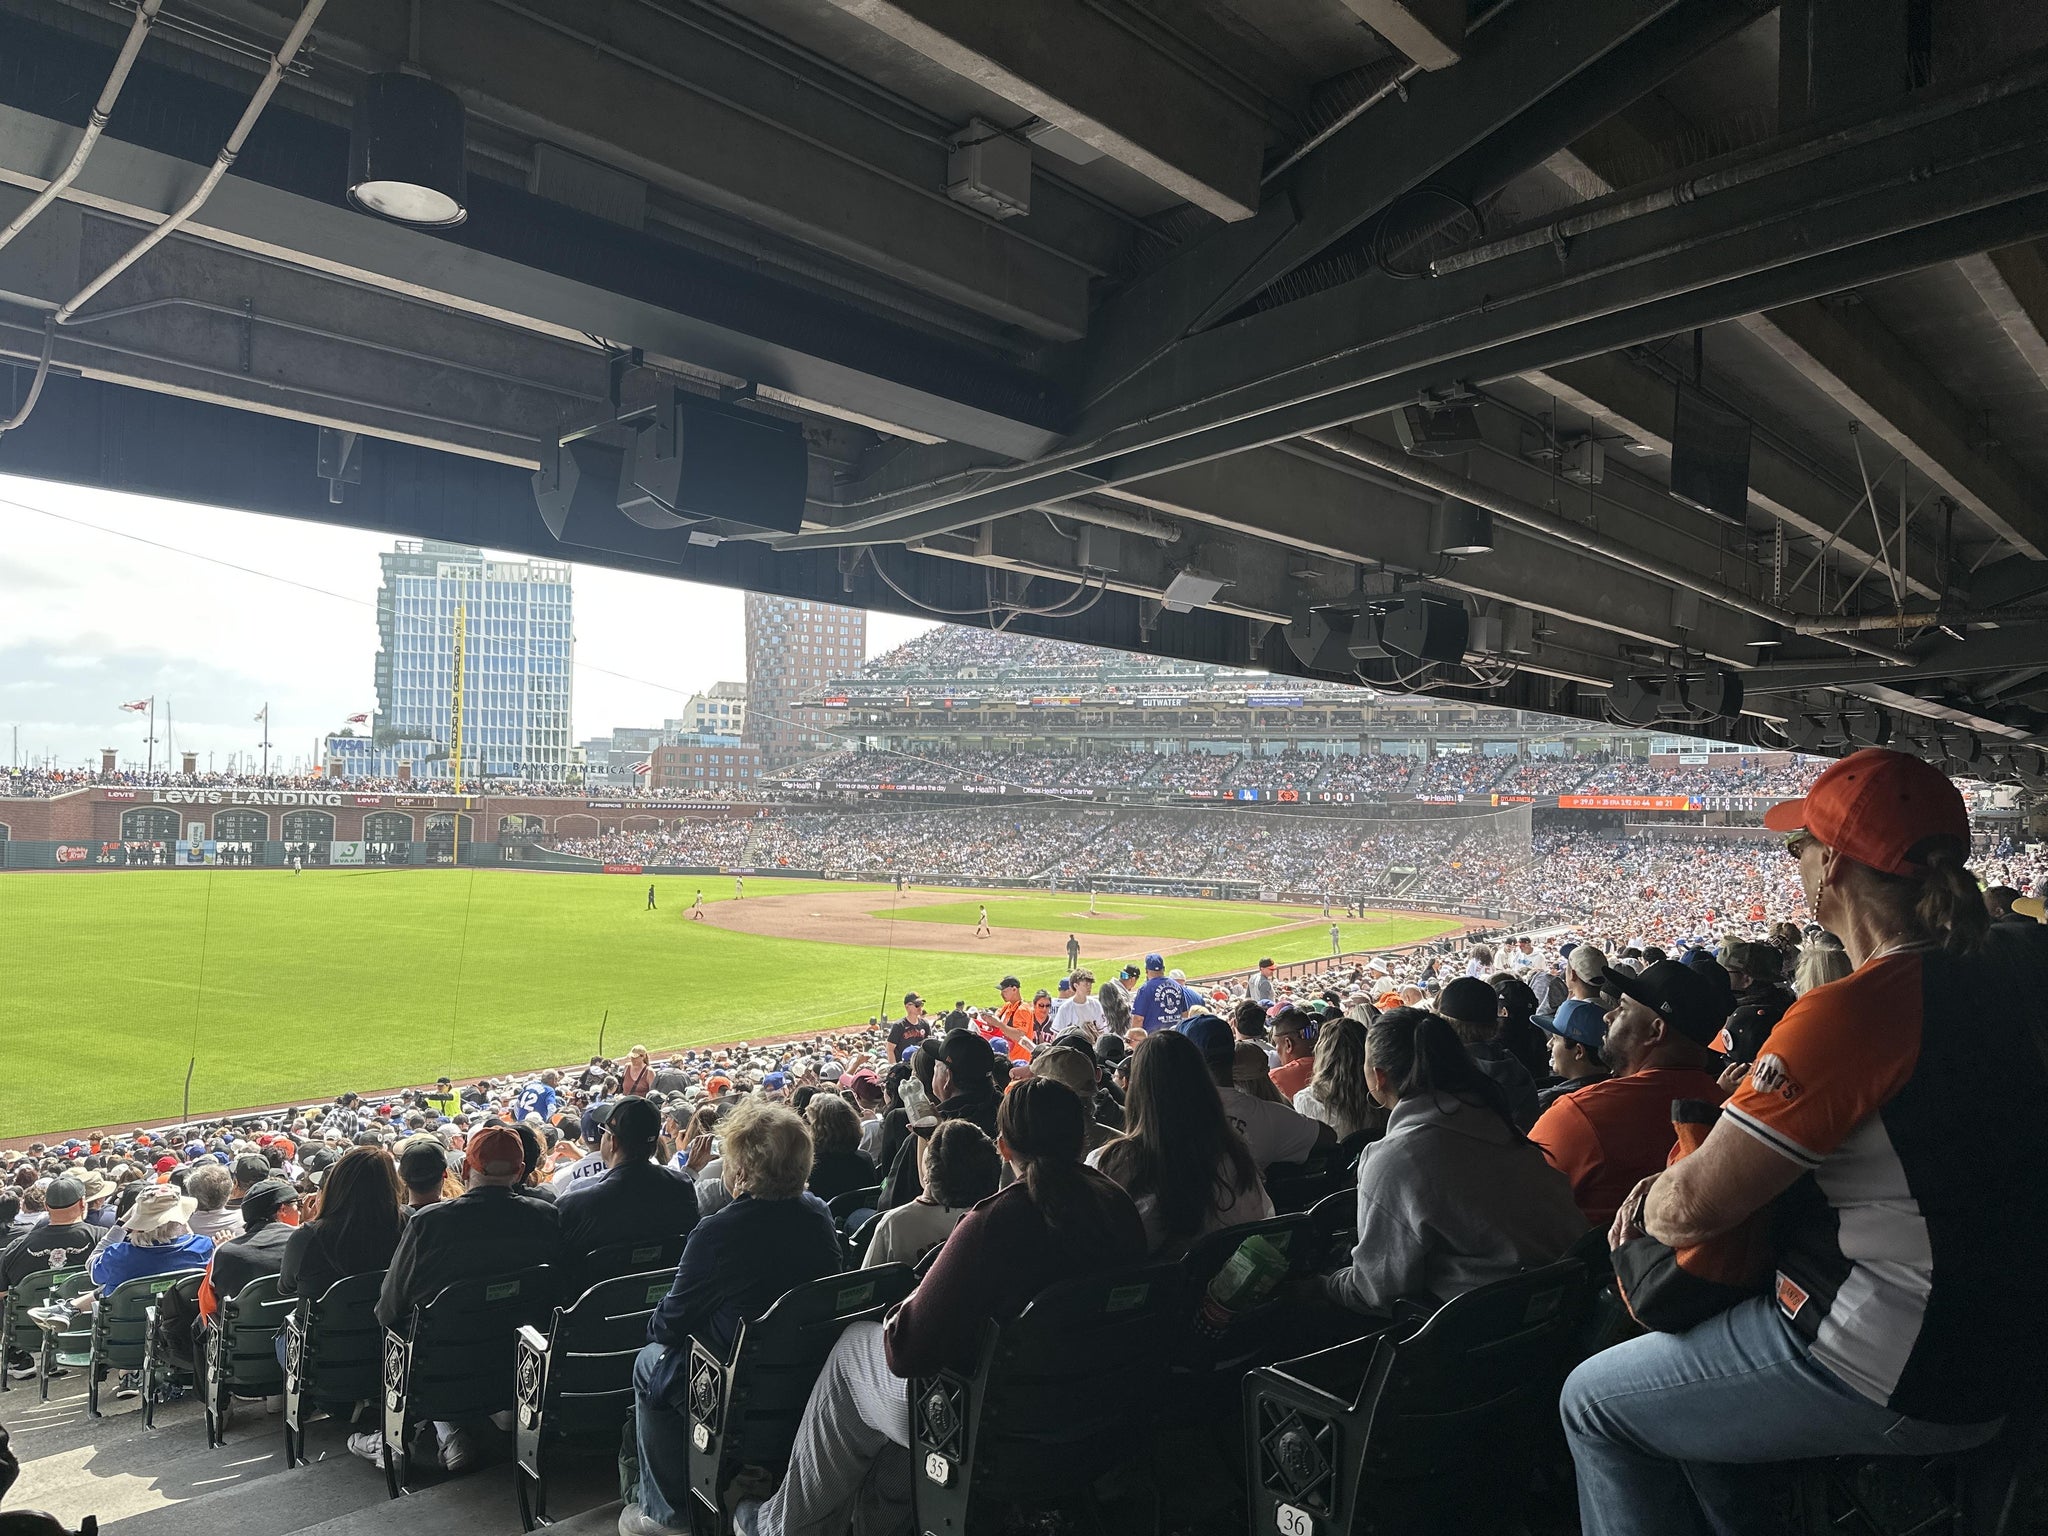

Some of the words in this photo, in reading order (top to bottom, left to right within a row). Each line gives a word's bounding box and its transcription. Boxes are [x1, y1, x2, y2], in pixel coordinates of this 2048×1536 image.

[332, 739, 364, 750] VISA
[512, 762, 548, 772] BANK
[551, 764, 567, 773] OF
[570, 764, 625, 775] AMERICA
[793, 782, 812, 790] Health
[936, 784, 947, 792] day
[975, 785, 997, 794] Health
[1041, 787, 1059, 795] Health
[1073, 788, 1094, 796] Partner
[231, 792, 342, 806] LANDING
[1323, 792, 1331, 801] 0
[1336, 792, 1343, 801] 0
[1430, 794, 1454, 802] Health
[95, 855, 116, 863] 365
[437, 855, 454, 863] 309
[695, 1427, 706, 1445] 34
[929, 1457, 944, 1478] 35
[1283, 1510, 1305, 1536] 36
